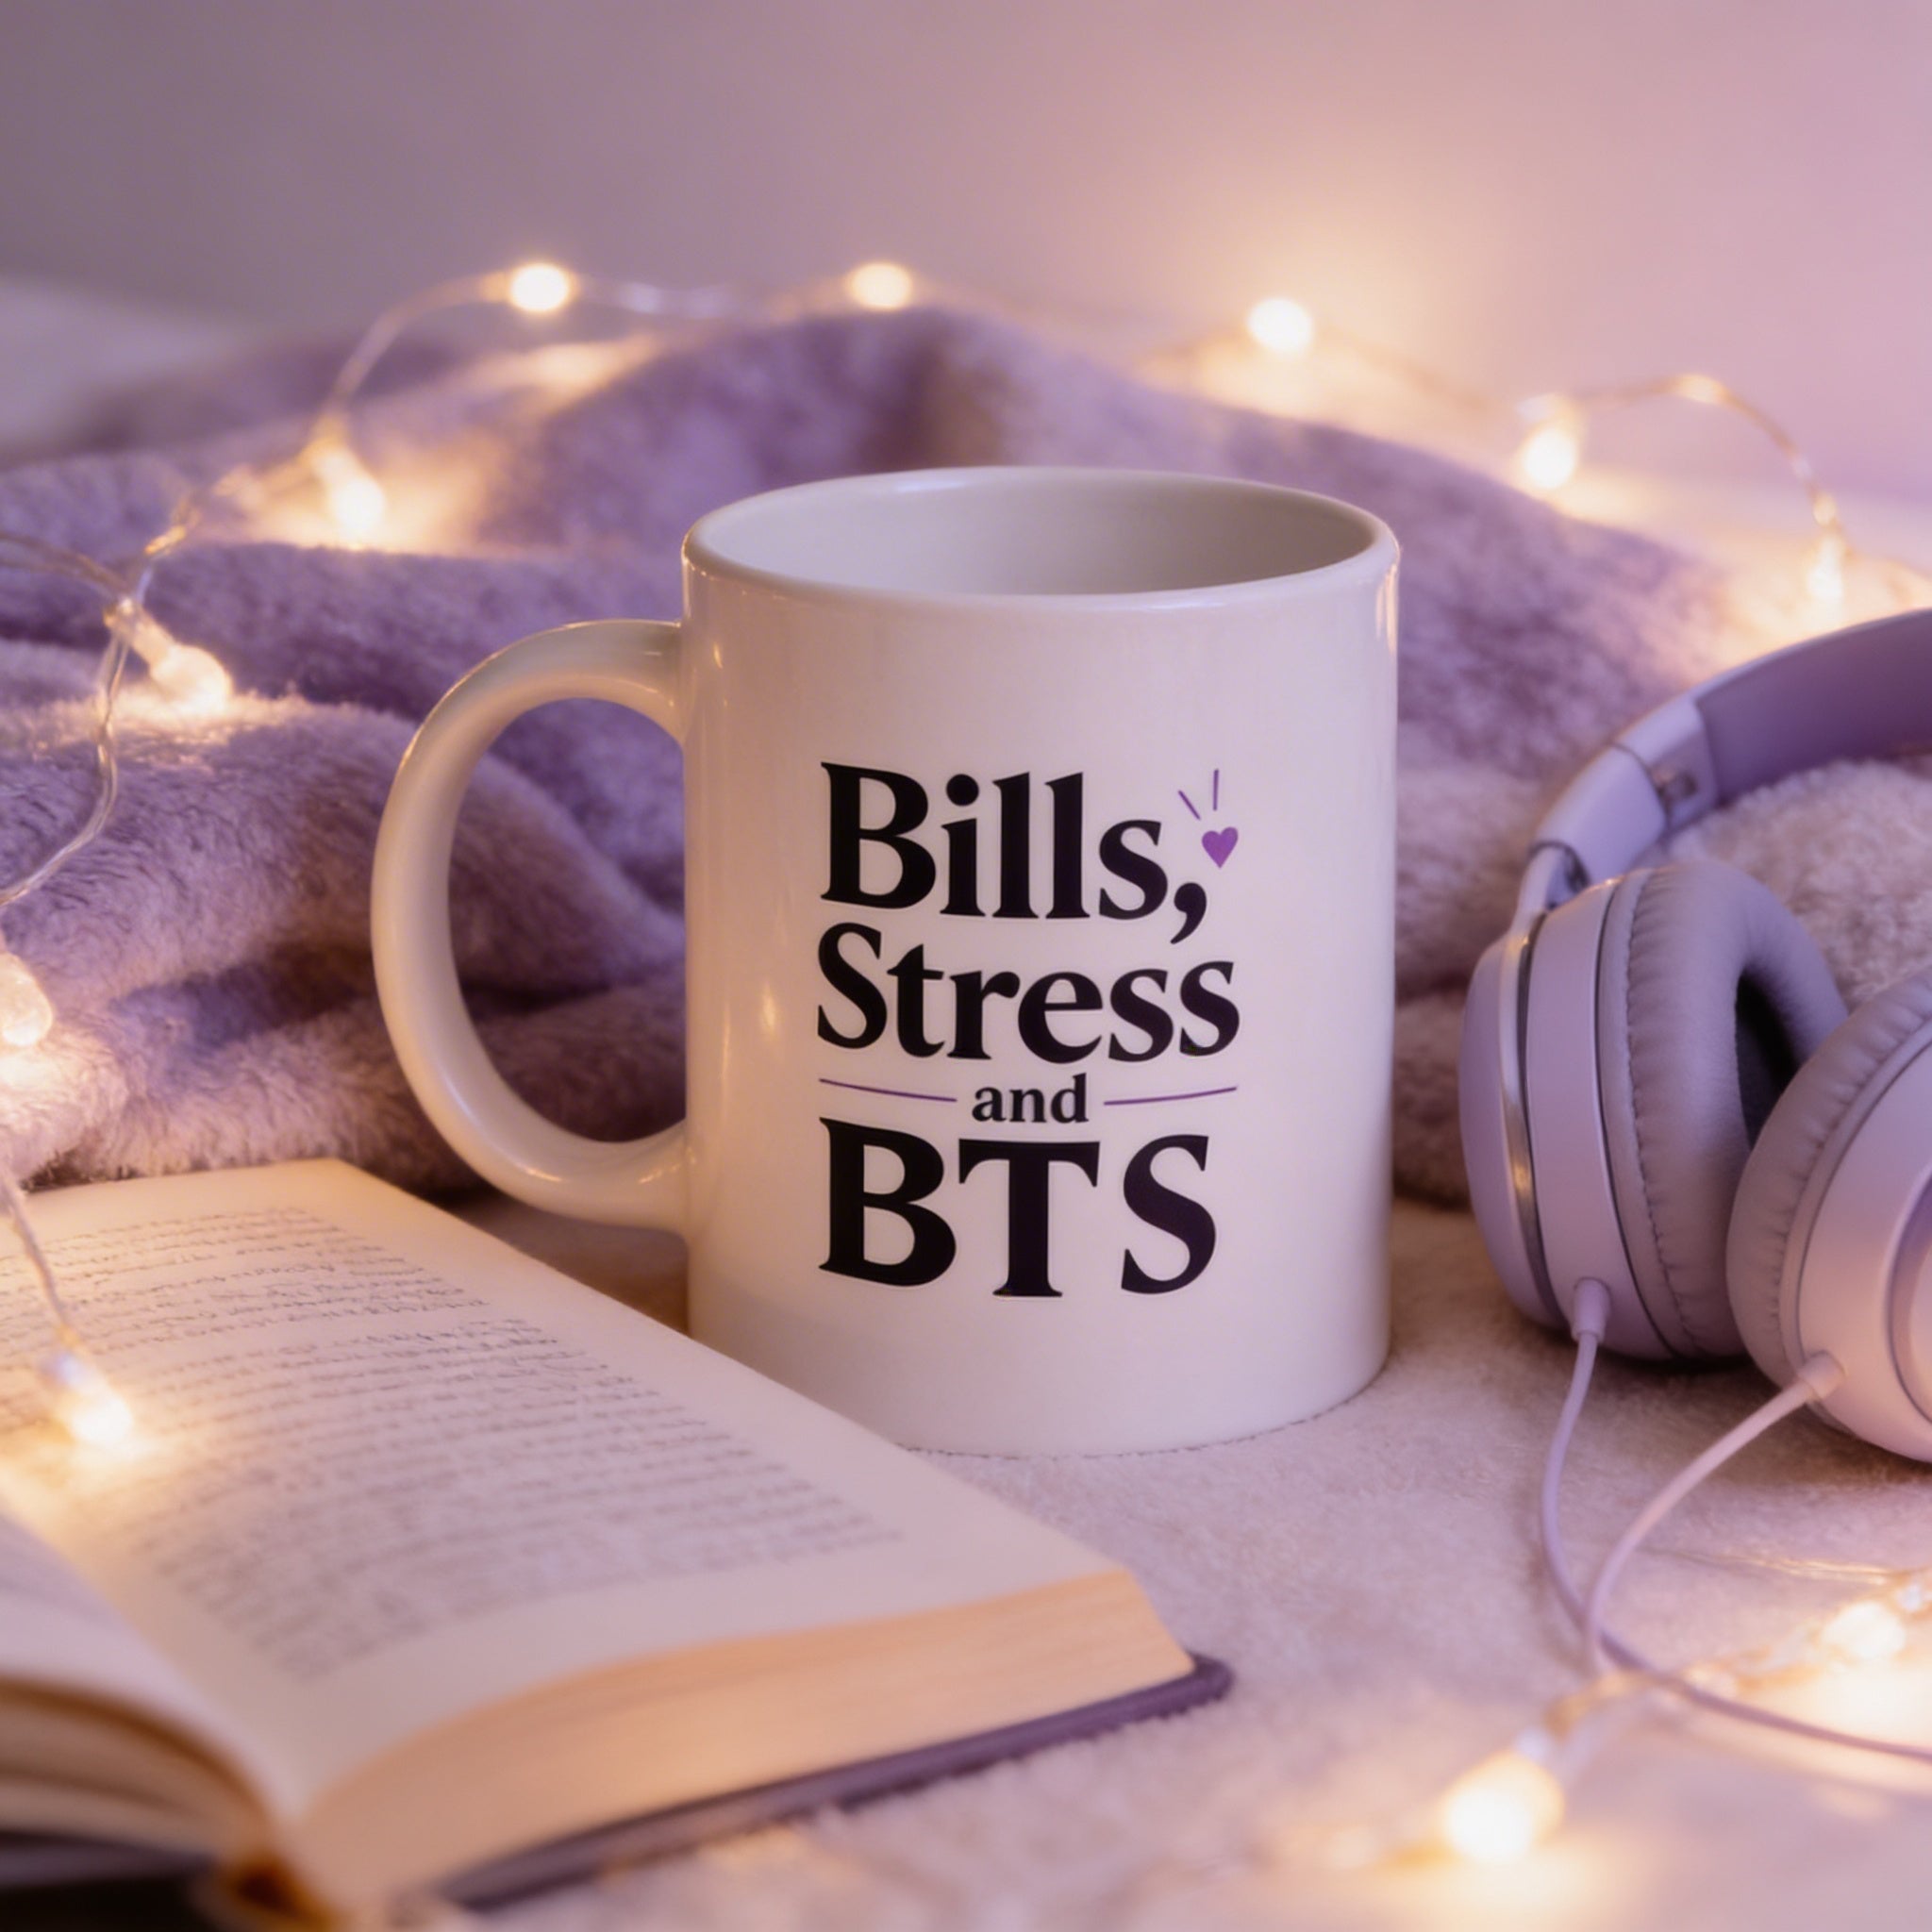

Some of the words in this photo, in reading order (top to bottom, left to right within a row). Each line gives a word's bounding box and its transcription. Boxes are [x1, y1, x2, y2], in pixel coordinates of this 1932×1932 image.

[820, 761, 1208, 944] Bills,
[817, 922, 1240, 1065] Stress
[972, 1073, 1090, 1124] and
[819, 1117, 1216, 1298] BTS
